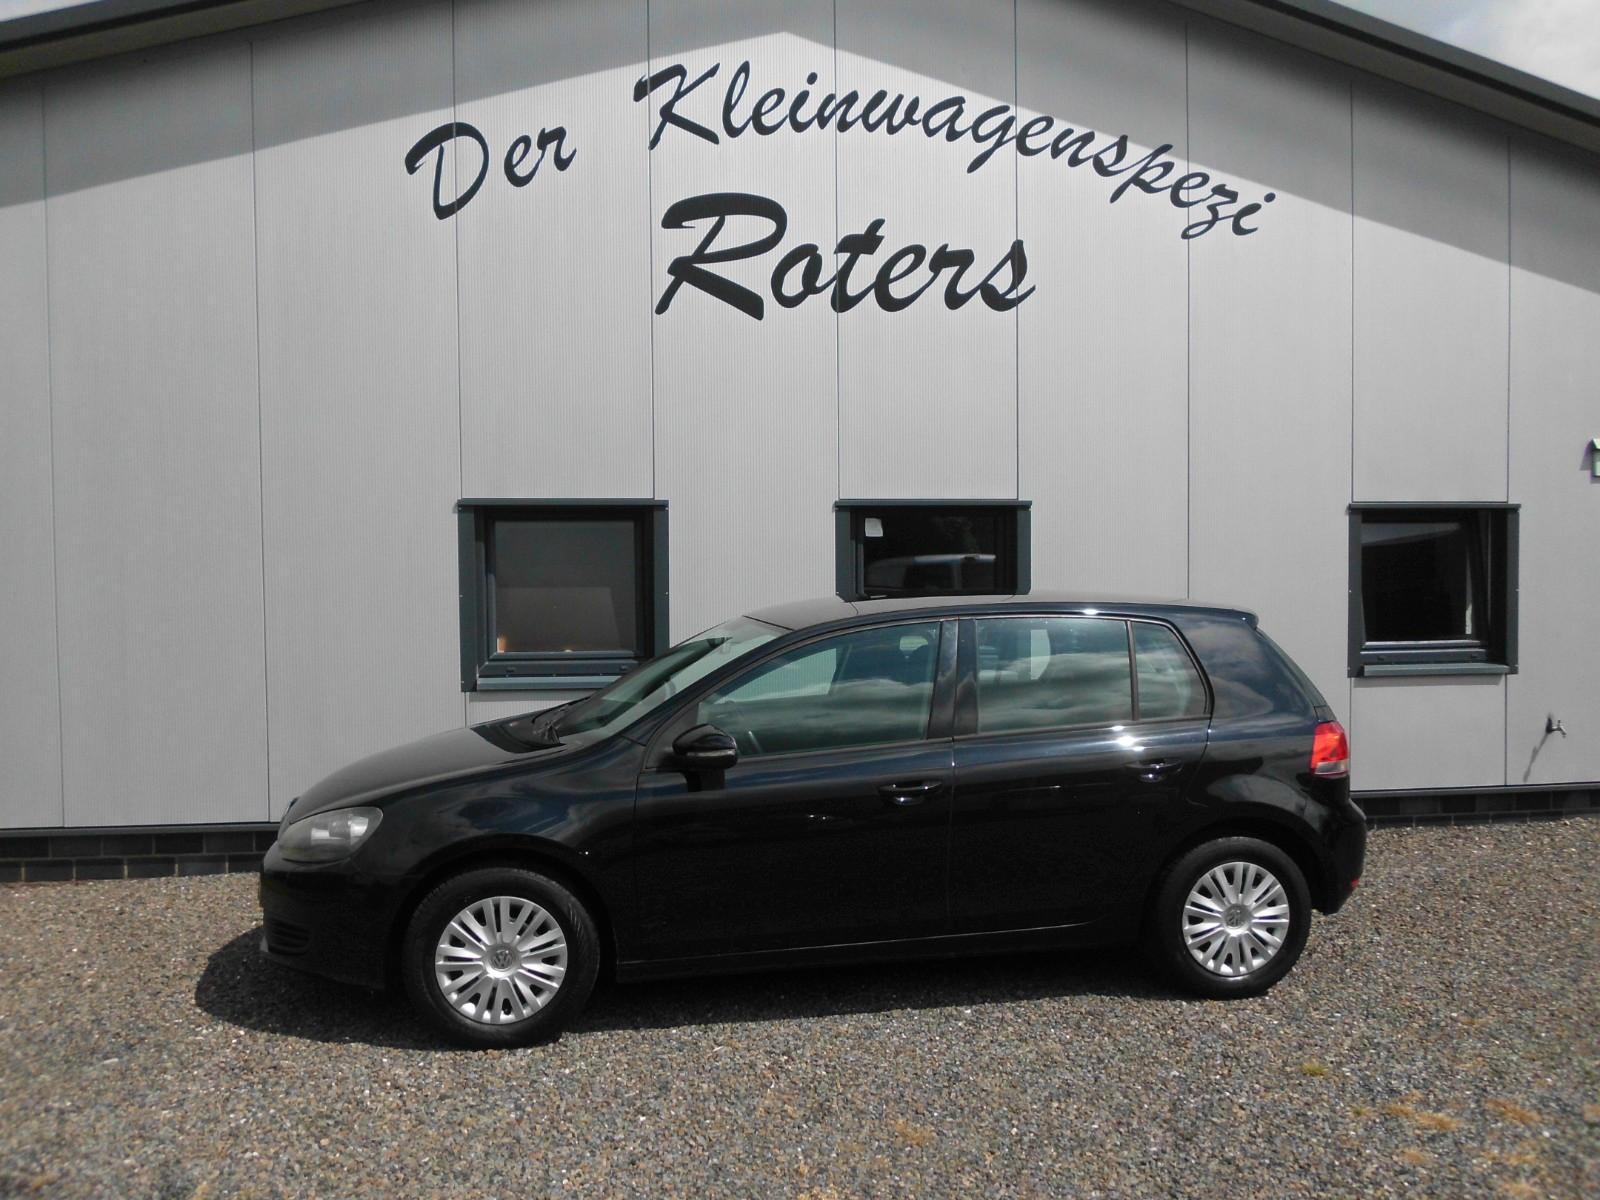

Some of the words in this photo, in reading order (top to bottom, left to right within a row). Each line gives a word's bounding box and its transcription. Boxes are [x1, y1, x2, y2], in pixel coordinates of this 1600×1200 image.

[405, 122, 577, 220] Der
[634, 61, 1276, 238] Kleinwagenspezi
[655, 193, 1036, 321] Roters
